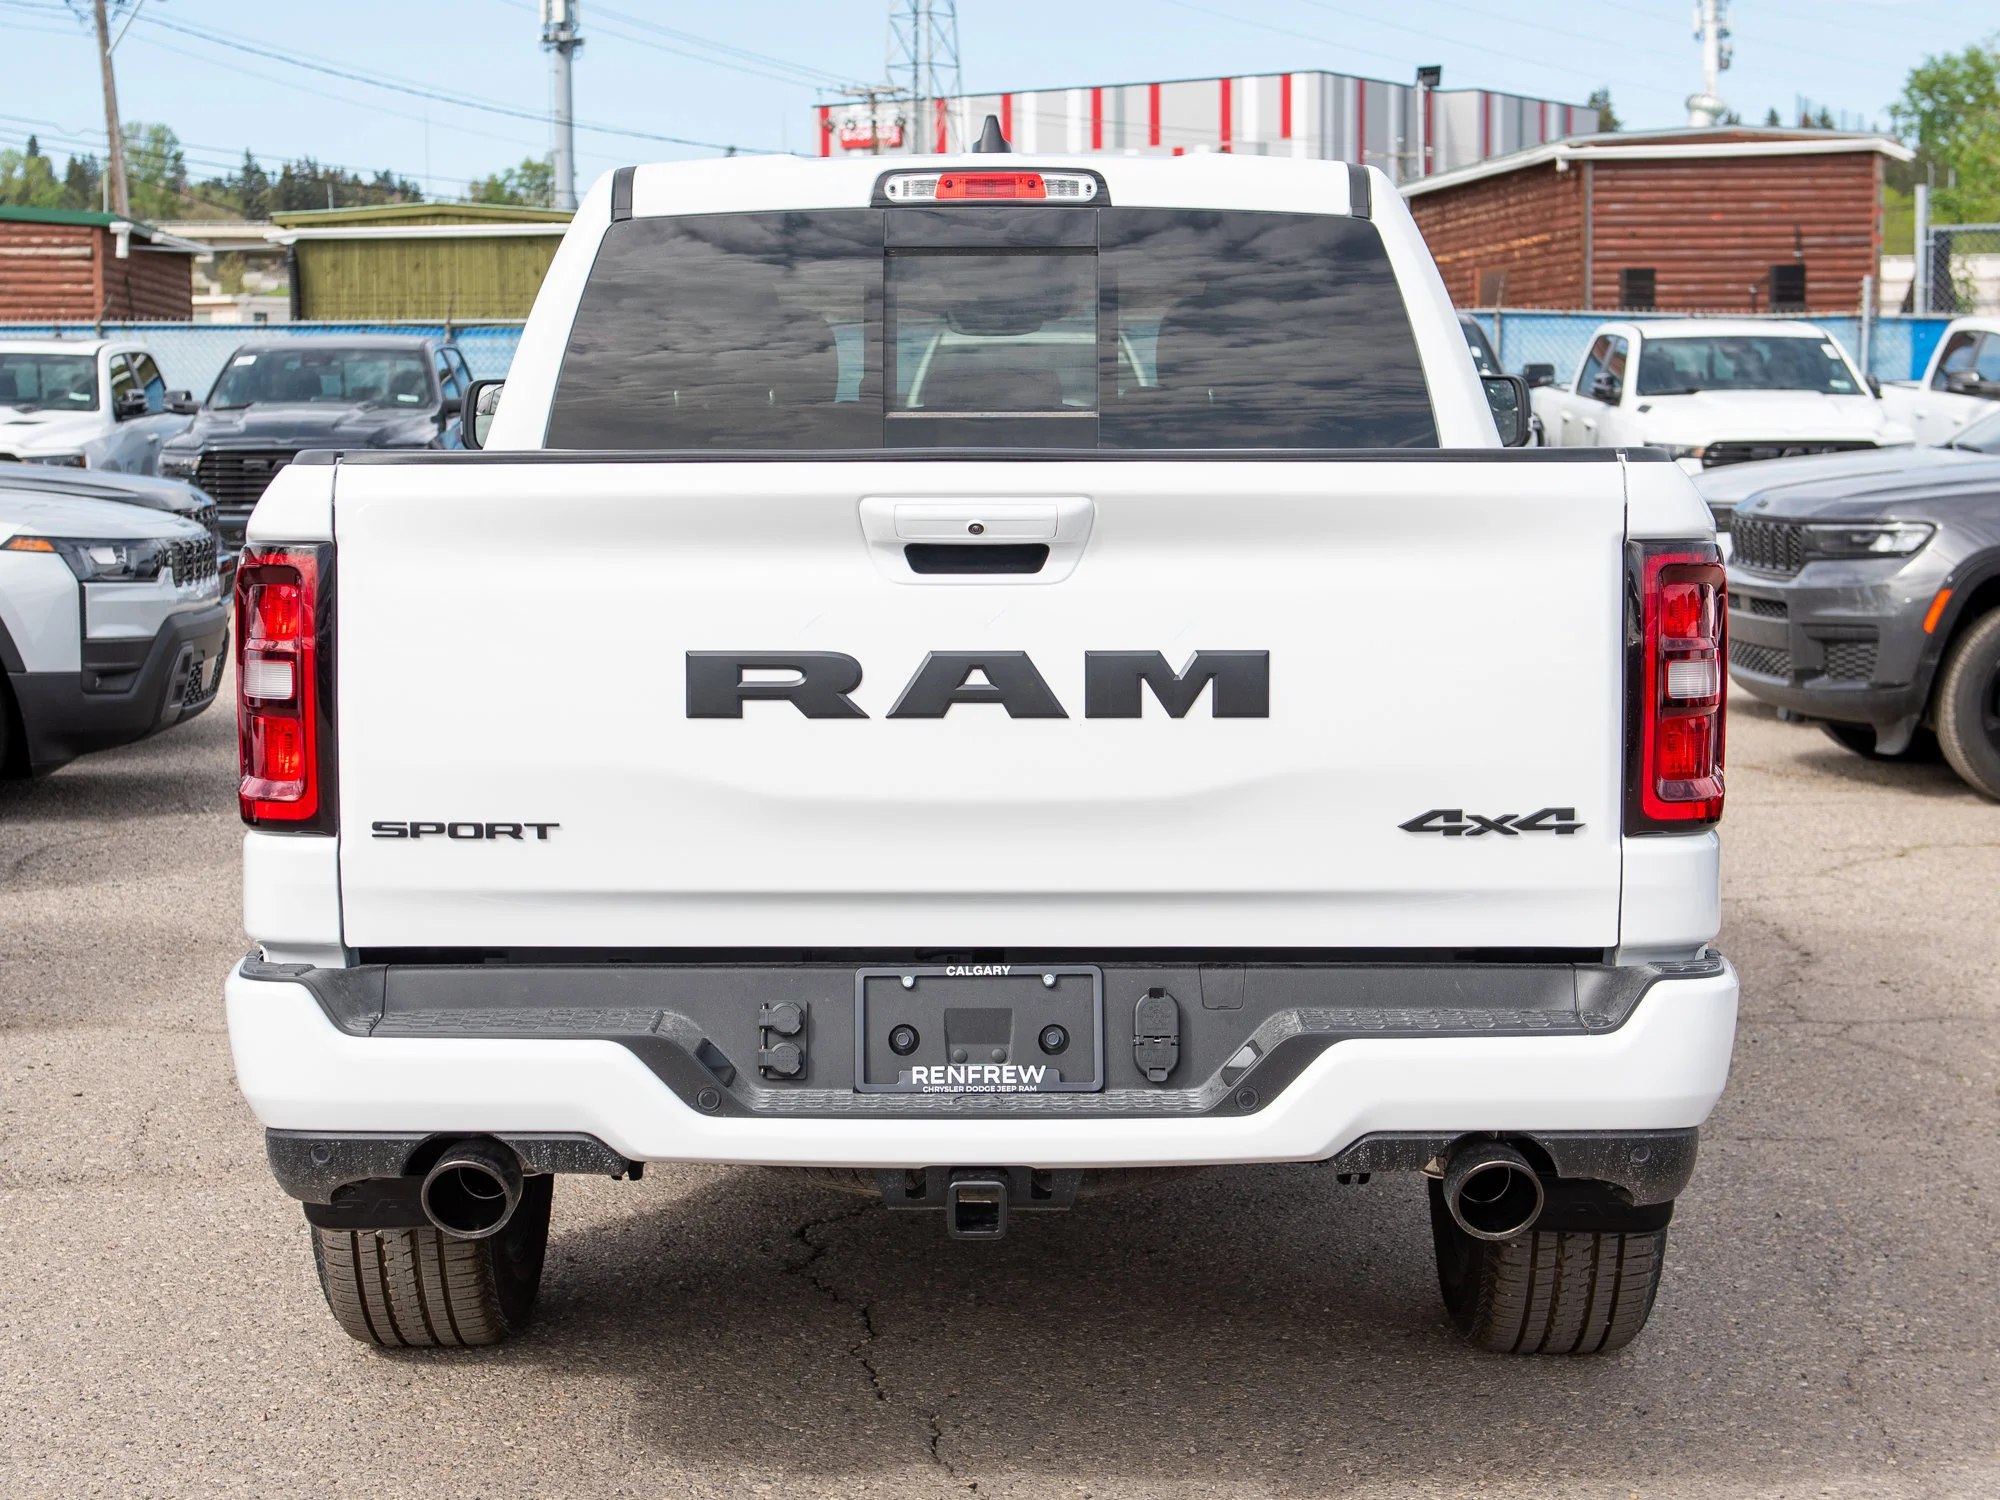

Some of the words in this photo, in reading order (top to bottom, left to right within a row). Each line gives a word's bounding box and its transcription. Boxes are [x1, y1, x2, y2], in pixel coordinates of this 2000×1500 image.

[686, 650, 1270, 719] RAM
[372, 821, 561, 840] SPORT
[1398, 807, 1586, 837] 4x4
[945, 965, 1011, 976] CALGARY
[911, 1064, 1047, 1085] RENFREW
[922, 1085, 965, 1093] CHRYSLER
[965, 1085, 996, 1093] DODGE
[996, 1085, 1017, 1093] JEEP
